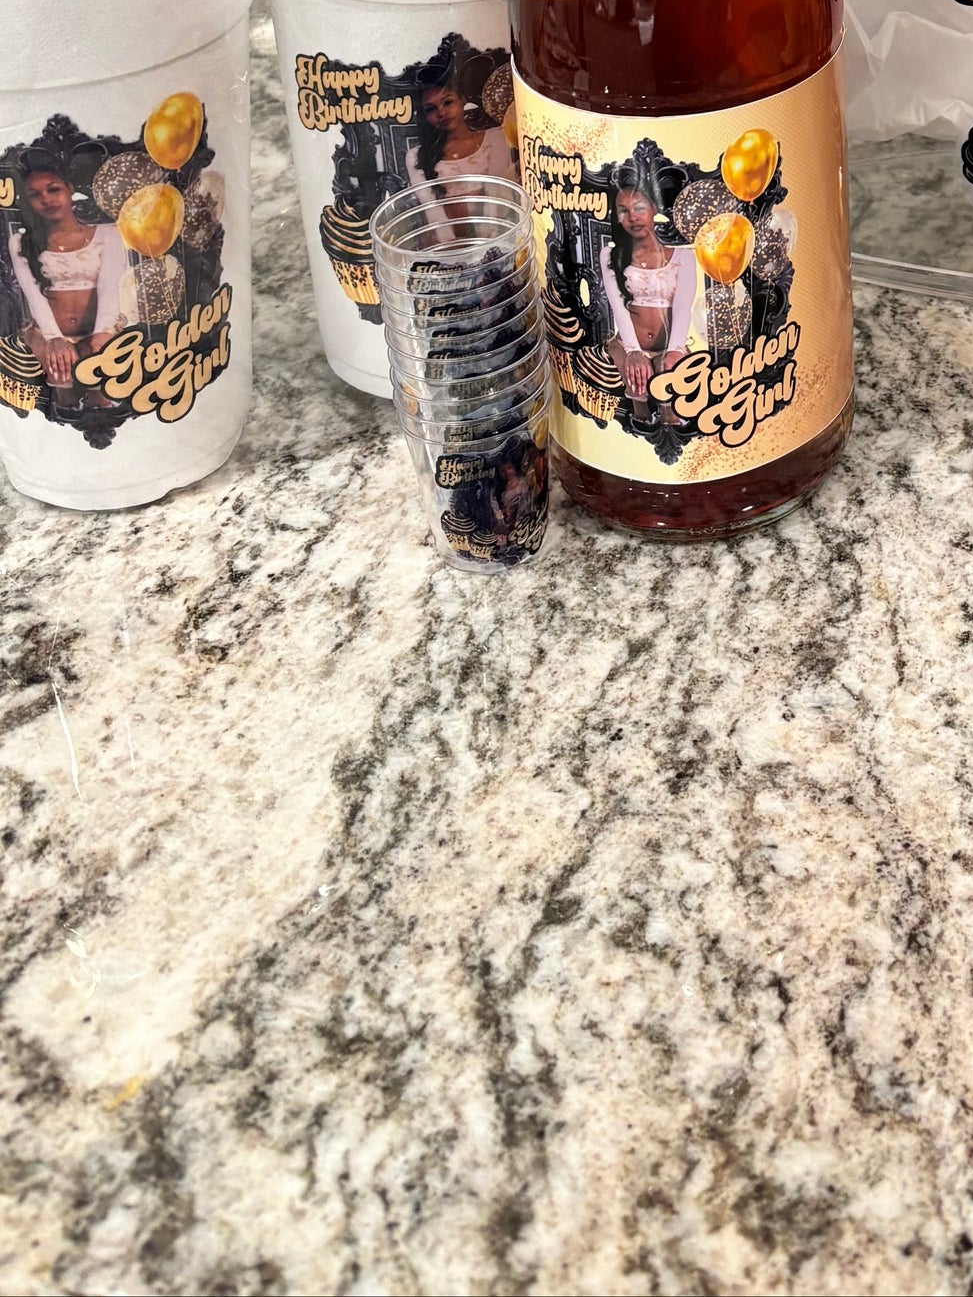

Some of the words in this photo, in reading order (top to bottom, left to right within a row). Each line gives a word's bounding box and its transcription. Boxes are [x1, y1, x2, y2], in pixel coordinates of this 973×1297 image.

[296, 55, 379, 97] Happy
[299, 89, 411, 131] Birthday
[523, 136, 581, 185] Happy
[525, 168, 607, 220] Birthday
[75, 288, 230, 398] Golden
[132, 326, 228, 420] Girl
[650, 324, 798, 417] Golden
[698, 363, 795, 445] Girl
